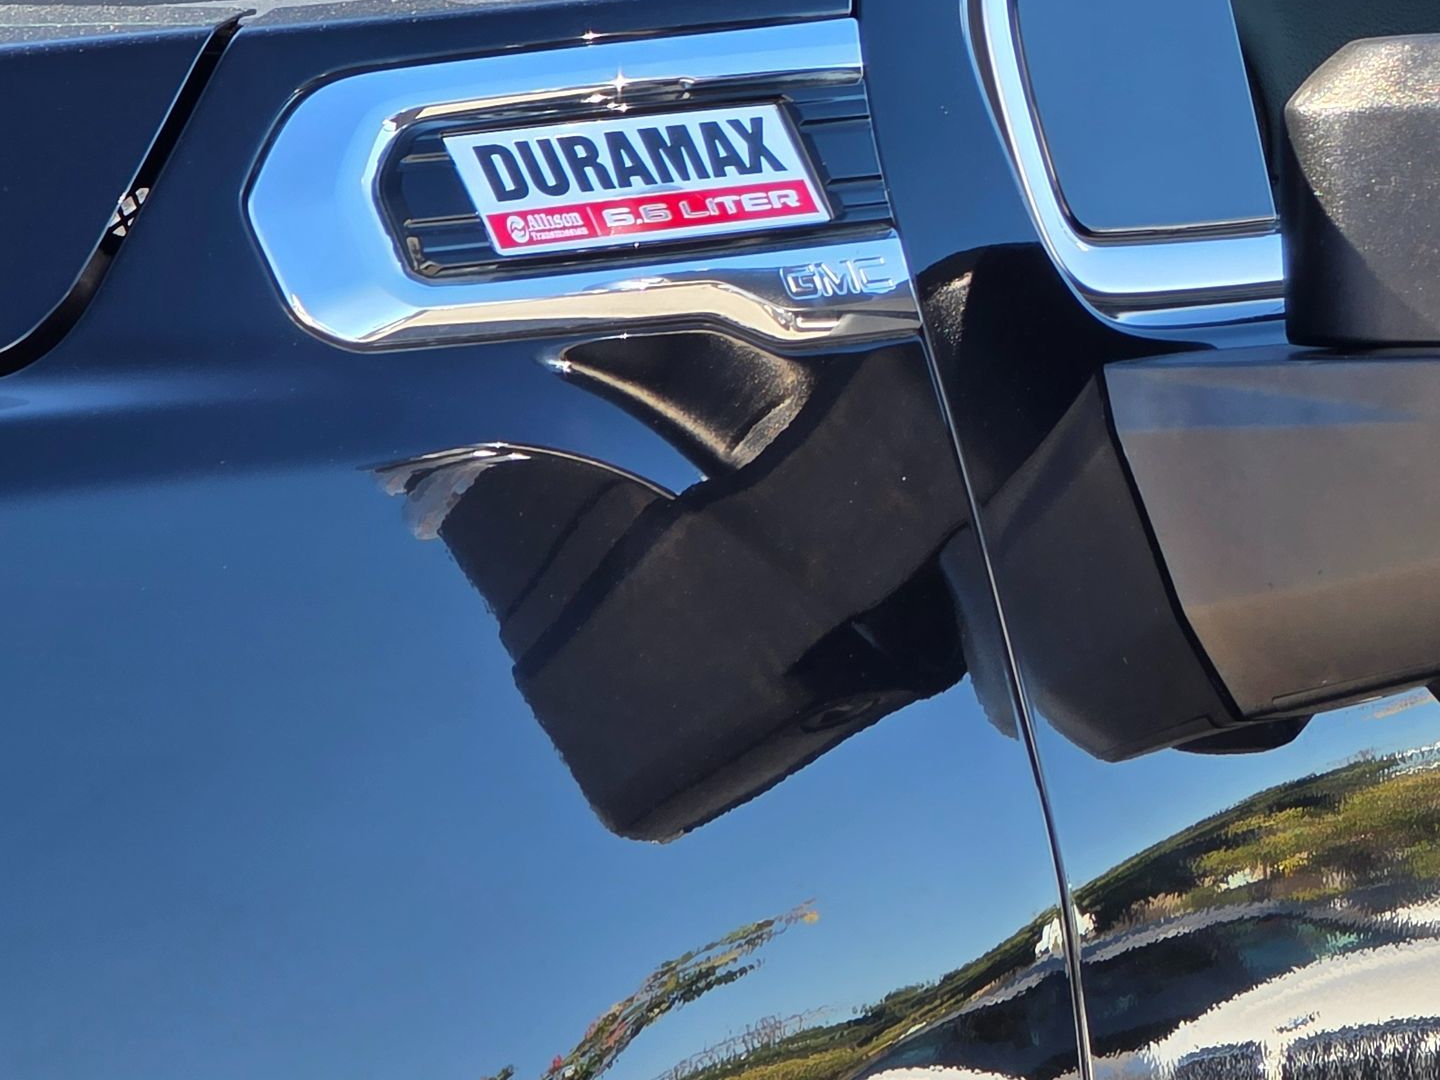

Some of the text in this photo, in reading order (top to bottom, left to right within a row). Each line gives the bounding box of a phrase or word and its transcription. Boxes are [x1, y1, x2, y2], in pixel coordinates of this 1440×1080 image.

[471, 115, 788, 203] DURAMAX
[526, 211, 584, 232] Allison
[602, 188, 801, 227] 6.6 LITER
[779, 254, 896, 301] GMC
